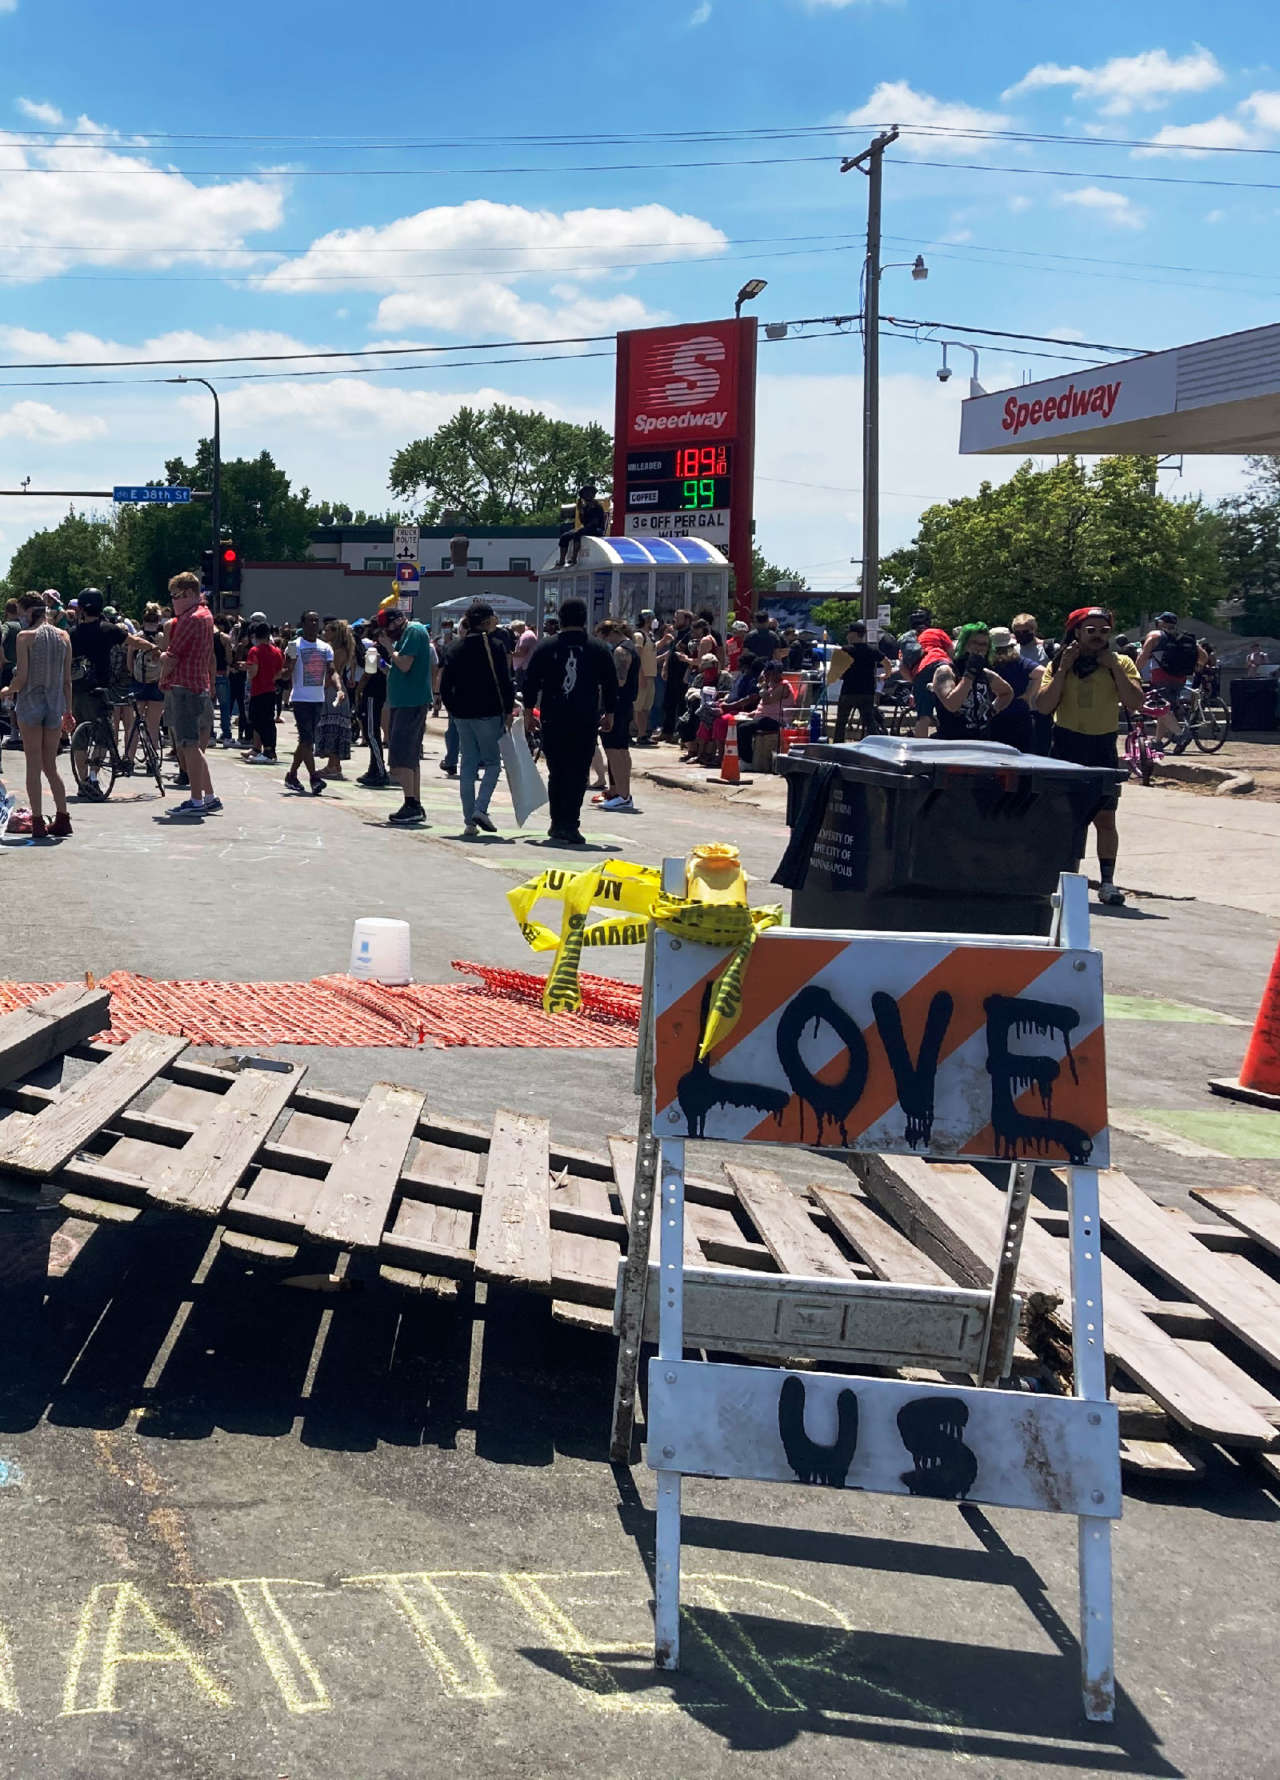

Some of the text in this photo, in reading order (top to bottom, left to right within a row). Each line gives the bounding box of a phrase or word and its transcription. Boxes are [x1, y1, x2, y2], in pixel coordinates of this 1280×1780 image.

[1001, 381, 1121, 435] Speedway
[634, 410, 727, 434] Speedway
[130, 489, 138, 499] E
[142, 489, 170, 500] 38th
[175, 489, 188, 500] St
[630, 492, 658, 503] COFFEE
[650, 516, 671, 529] OFF
[673, 515, 696, 528] PER
[698, 513, 724, 527] GAL
[396, 536, 417, 544] ROUTE
[397, 528, 417, 536] TRUCK
[844, 834, 855, 846] OF
[827, 844, 840, 858] CITY
[841, 849, 852, 860] OF
[677, 980, 1092, 1165] LOVE
[778, 1374, 979, 1500] US
